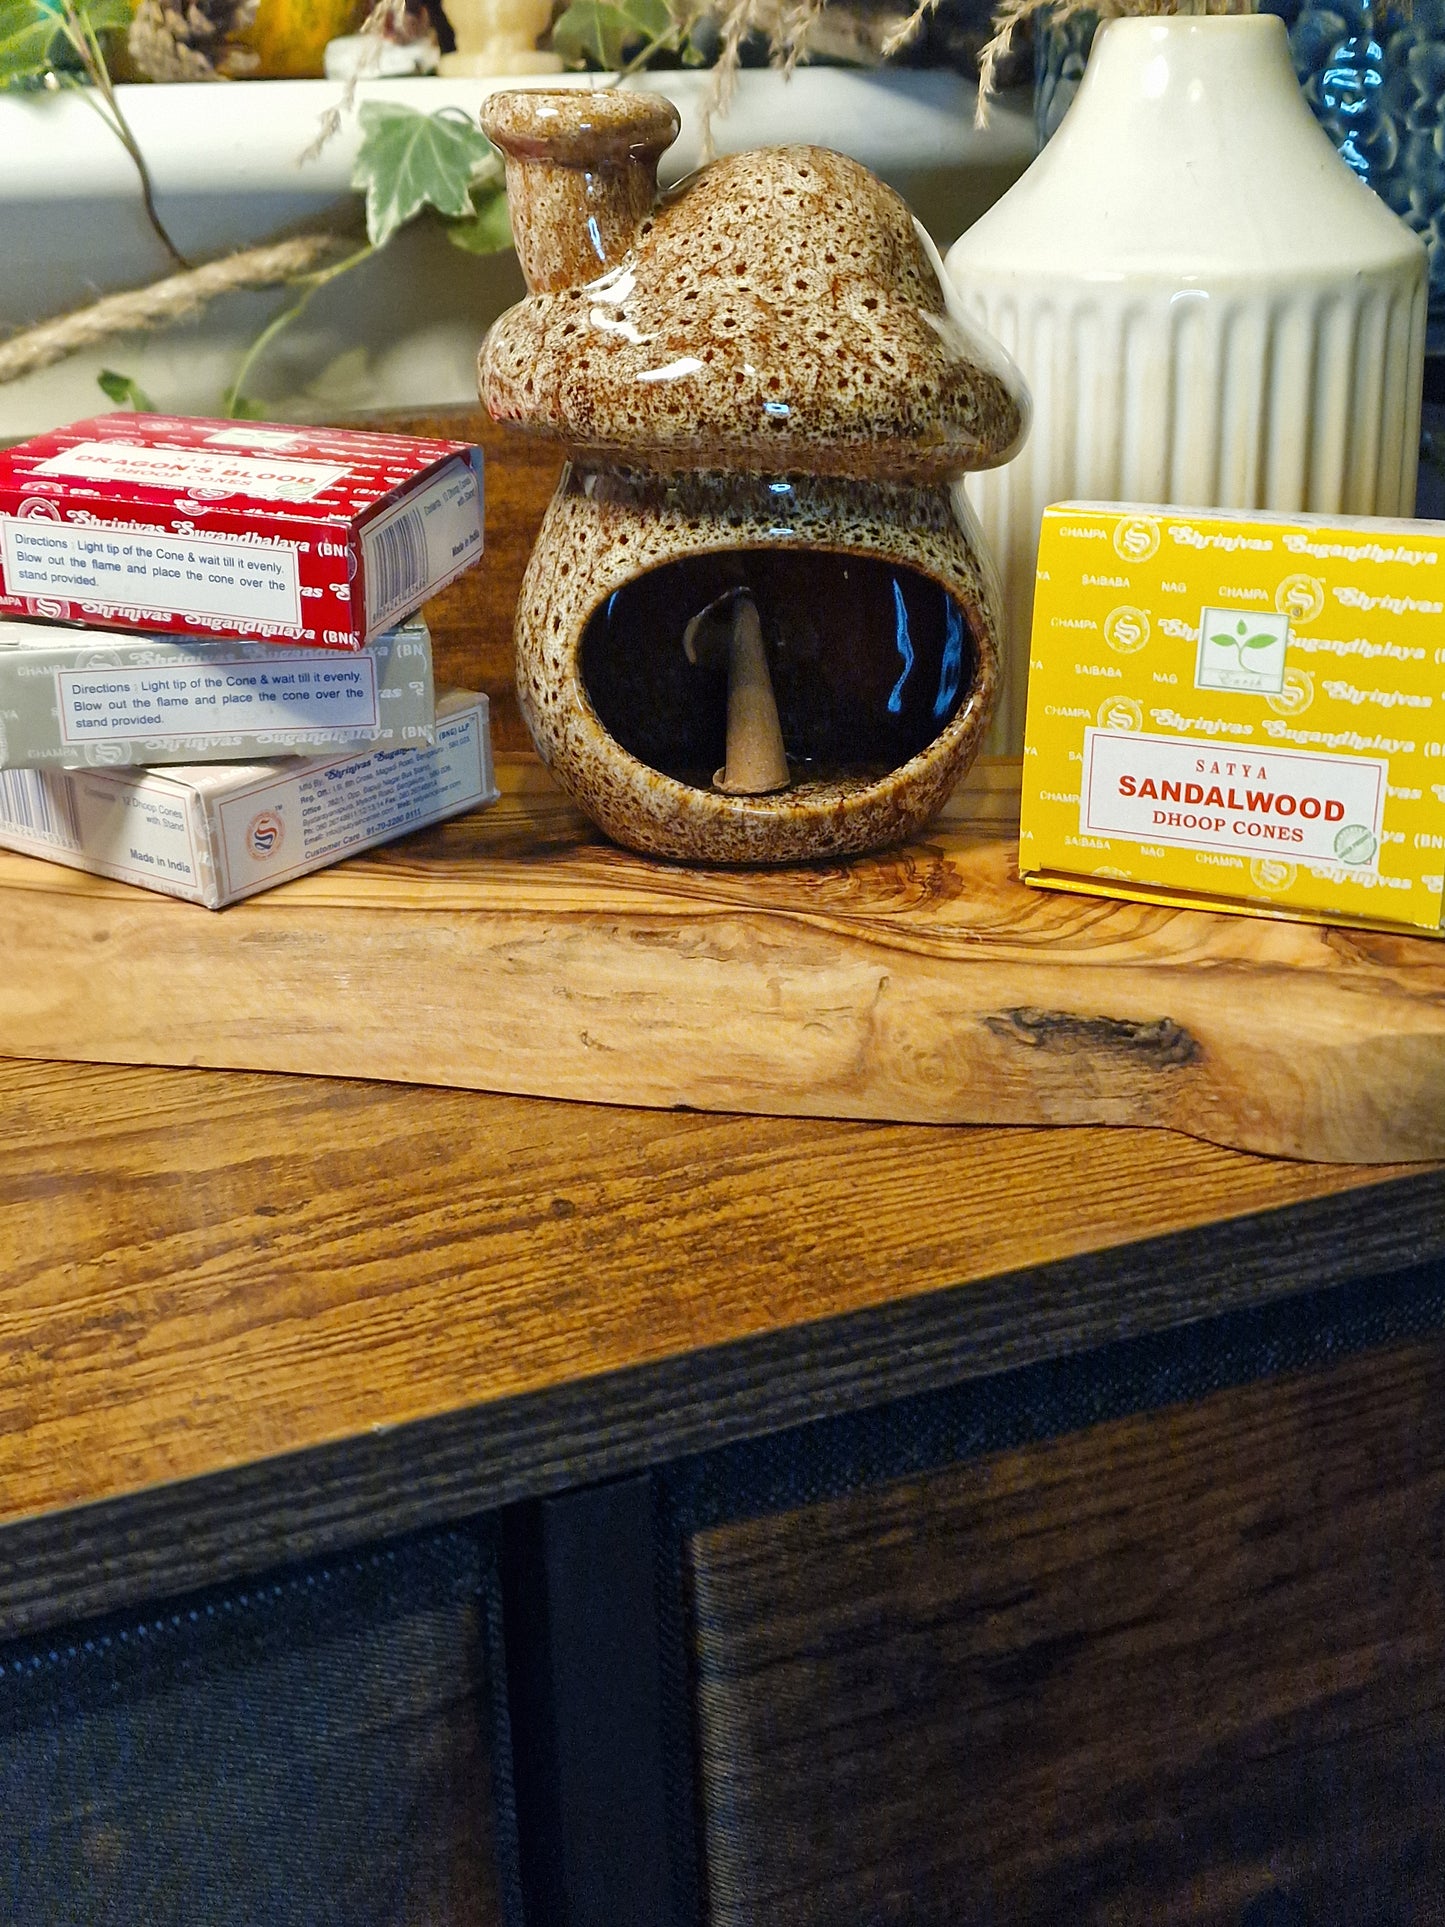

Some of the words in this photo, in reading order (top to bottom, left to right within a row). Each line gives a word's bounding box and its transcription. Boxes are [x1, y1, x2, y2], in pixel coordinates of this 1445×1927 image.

[75, 455, 214, 473] DRAGON'S
[222, 470, 316, 484] BLOOD
[1060, 527, 1107, 540] CHAMPA
[15, 533, 68, 549] Directions
[77, 540, 104, 554] Light
[107, 543, 119, 556] tip
[123, 545, 133, 555] of
[136, 547, 152, 557] the
[156, 548, 184, 561] Cone
[188, 552, 195, 562] &
[199, 555, 220, 567] wait
[223, 557, 234, 567] till
[238, 558, 244, 568] it
[247, 561, 284, 575] evenly.
[17, 551, 42, 563] Blow
[48, 556, 65, 566] out
[70, 557, 86, 568] the
[92, 559, 121, 571] flame
[127, 564, 147, 574] and
[152, 566, 180, 578] place
[186, 570, 203, 581] the
[208, 574, 234, 585] cone
[240, 578, 263, 588] over
[269, 580, 286, 591] the
[19, 570, 48, 581] stand
[1161, 581, 1187, 593] NAG
[1218, 586, 1269, 601] CHAMPA
[1051, 617, 1097, 630] CHAMPA
[72, 684, 130, 695] Directions
[141, 680, 170, 692] Light
[173, 680, 187, 691] tip
[190, 679, 201, 688] of
[205, 678, 223, 687] the
[226, 676, 257, 687] Cone
[260, 675, 269, 684] &
[272, 674, 294, 684] wait
[298, 673, 310, 683] till
[314, 672, 321, 682] it
[324, 671, 362, 685] evenly.
[1153, 672, 1178, 685] NAG
[74, 701, 102, 712] Blow
[108, 700, 127, 710] out
[133, 699, 151, 708] the
[157, 697, 189, 707] flame
[194, 695, 216, 705] and
[222, 693, 253, 706] place
[258, 692, 276, 701] the
[283, 691, 310, 701] cone
[315, 690, 340, 699] over
[346, 689, 364, 698] the
[76, 717, 108, 728] stand
[111, 714, 165, 728] provided.
[1044, 705, 1091, 719] CHAMPA
[1195, 759, 1267, 780] SATYA
[1118, 775, 1345, 822] SANDALWOOD
[159, 805, 183, 819] Cones
[163, 819, 185, 832] Stand
[1152, 810, 1226, 832] DHOOP
[1232, 820, 1304, 843] CONES
[305, 841, 340, 859] Customer
[343, 833, 360, 844] Care
[130, 849, 155, 864] Made
[157, 856, 165, 867] in
[168, 859, 191, 873] India
[1141, 846, 1165, 857] NAG
[1195, 853, 1243, 869] CHAMPA
